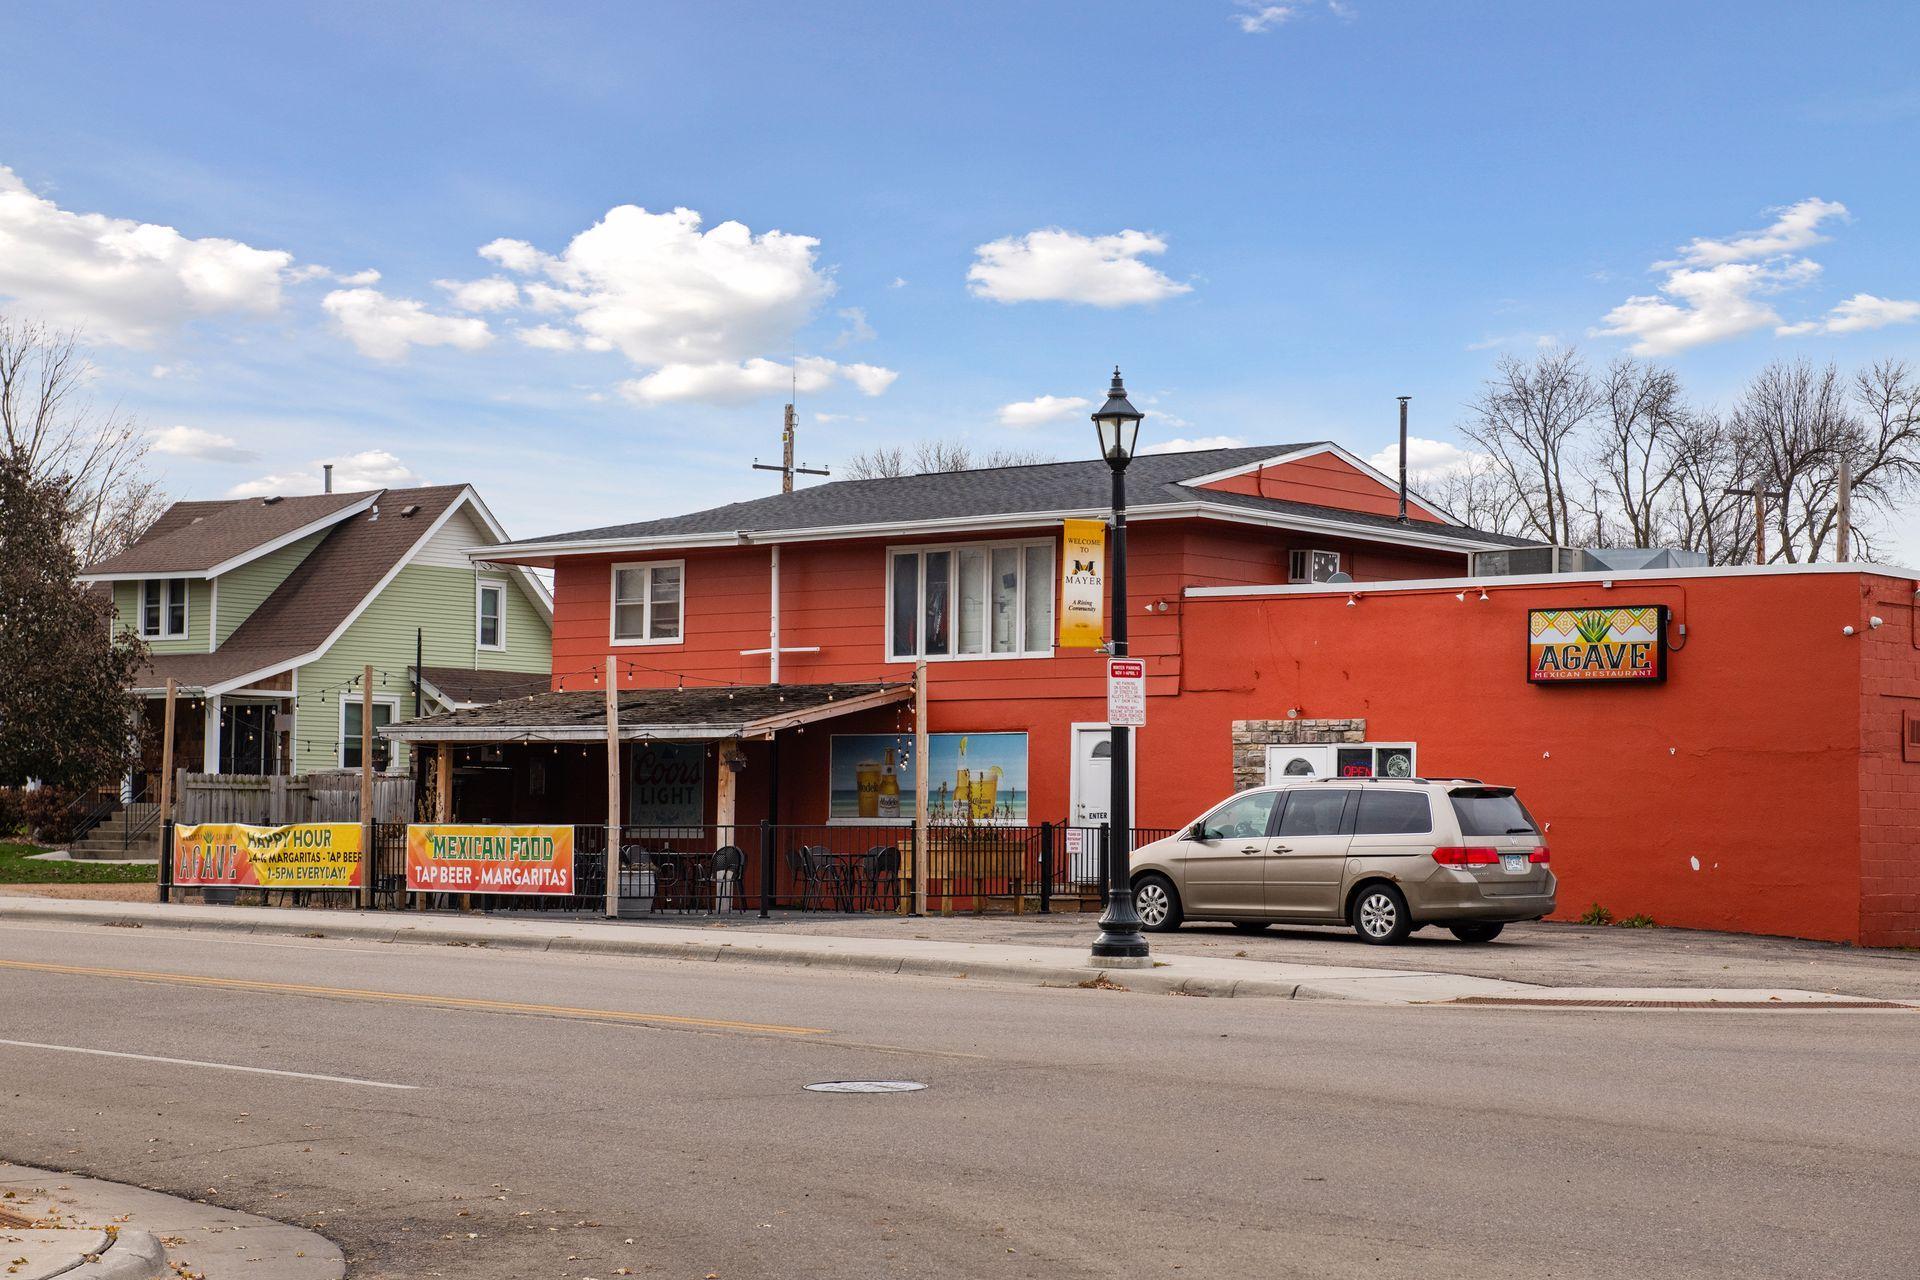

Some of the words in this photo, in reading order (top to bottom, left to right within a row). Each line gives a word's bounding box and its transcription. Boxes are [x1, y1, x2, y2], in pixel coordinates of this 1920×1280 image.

[1065, 576, 1102, 585] MAYER
[1068, 605, 1096, 613] Community
[1536, 643, 1653, 671] AGAVE
[634, 751, 701, 785] Coors
[1344, 765, 1372, 777] OPEN
[640, 786, 695, 805] LIGHT
[247, 830, 291, 848] HAPPY
[293, 829, 332, 848] HOUR
[268, 851, 321, 863] MARGARITAS
[327, 852, 342, 862] TAP
[343, 852, 362, 863] BEER
[432, 835, 507, 861] MEXICAN
[510, 836, 555, 862] FOOD
[297, 866, 347, 880] EVERYDAY!
[415, 865, 437, 883] TAP
[440, 866, 472, 884] BEER
[480, 867, 567, 887] MARGARITAS
